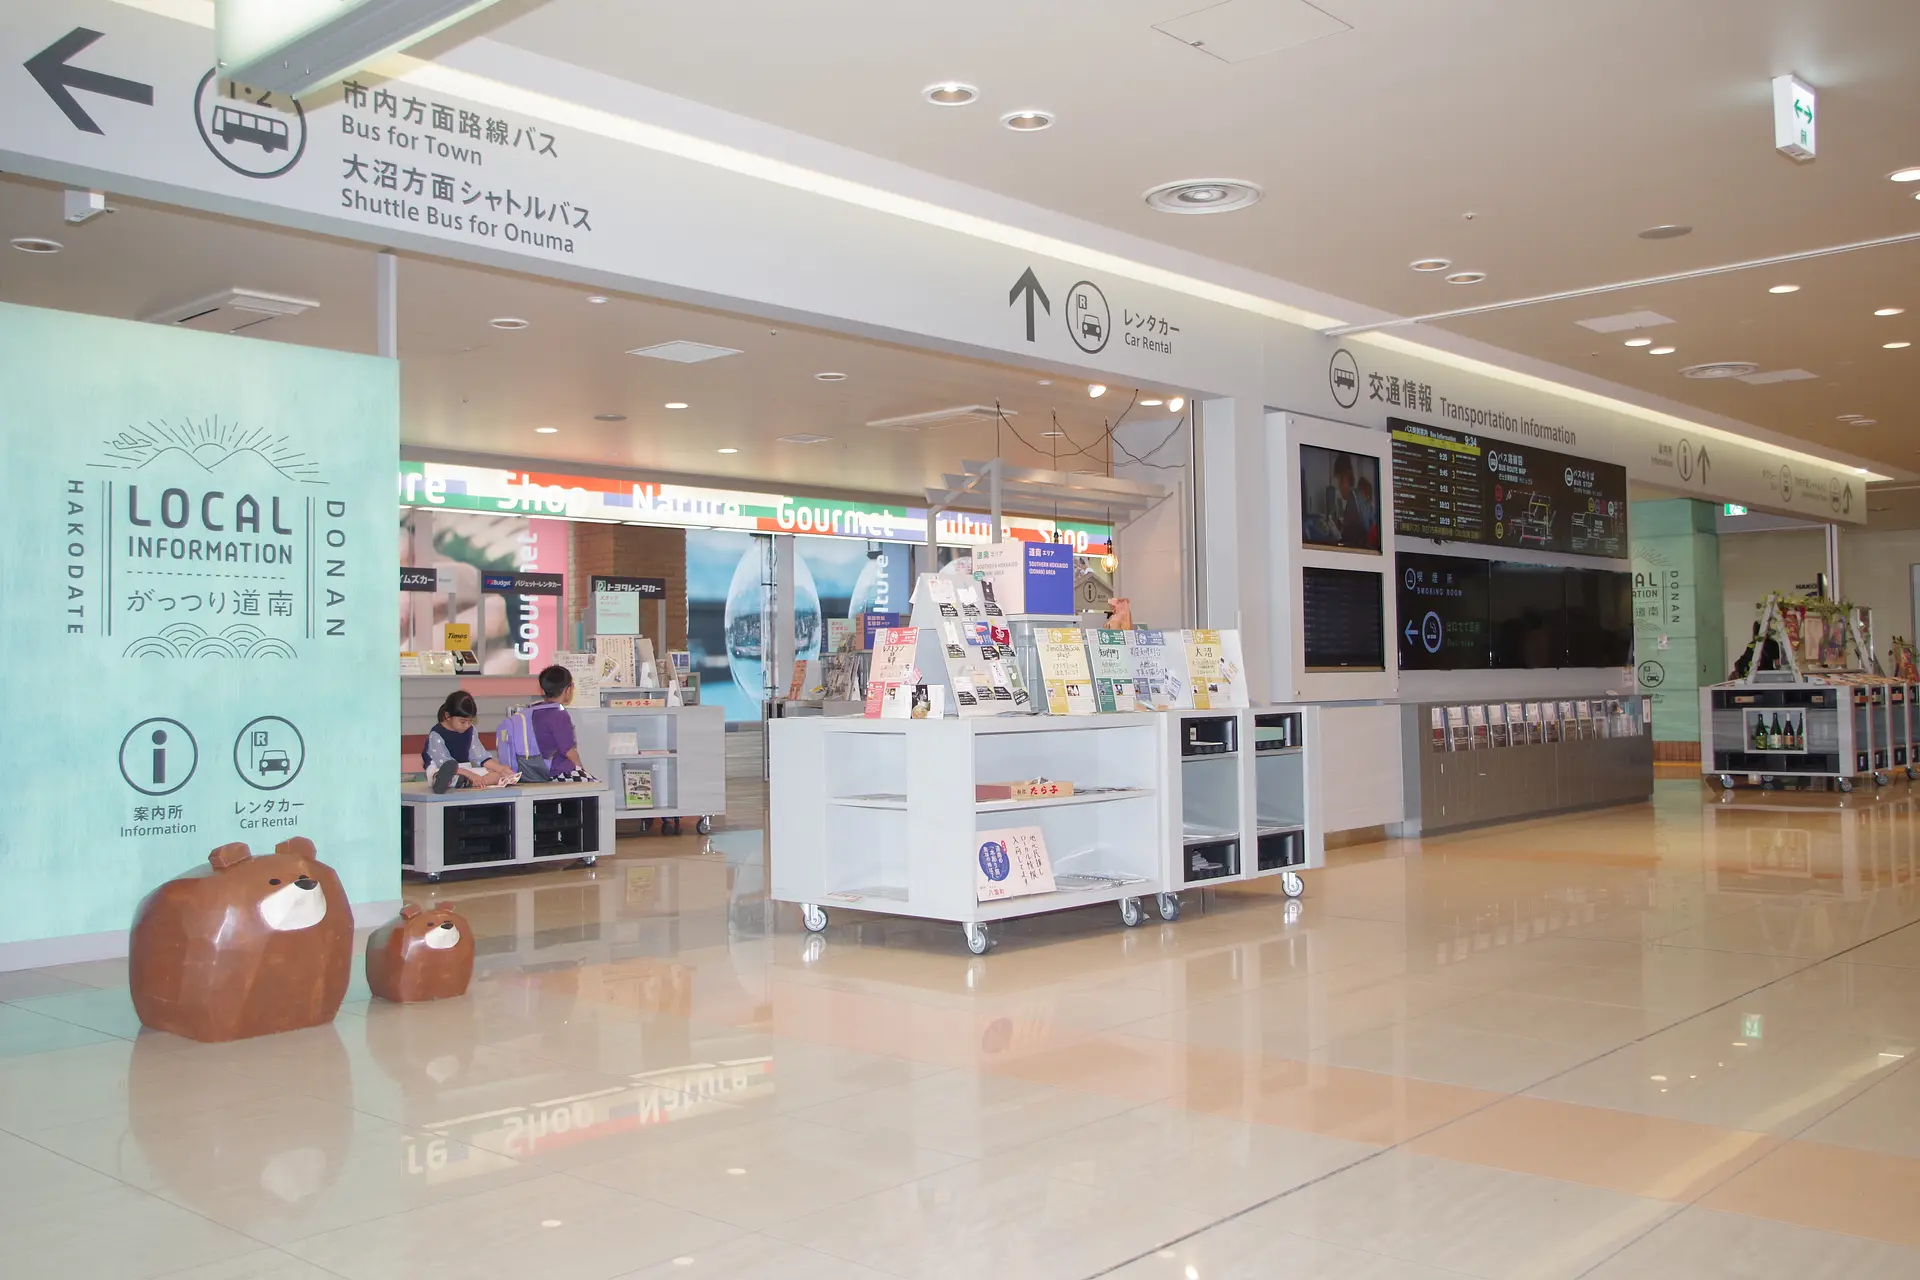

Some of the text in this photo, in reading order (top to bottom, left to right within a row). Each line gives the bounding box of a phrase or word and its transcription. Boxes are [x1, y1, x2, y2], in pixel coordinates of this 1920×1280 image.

[342, 80, 559, 159] 市内方面路線バス
[342, 114, 482, 166] Bus for Town
[342, 154, 592, 232] 大沼方面シャトルバス
[342, 188, 574, 254] Shuttle Bus for Onuma
[1124, 308, 1180, 337] レンタカー
[1124, 332, 1172, 354] Car Rental
[1368, 371, 1433, 413] 交通情報
[1440, 396, 1576, 446] Transportation Information
[1464, 435, 1477, 448] 9:34
[129, 485, 293, 536] LOCAL
[777, 497, 894, 537] Gourmet
[67, 479, 84, 634] HAKODATE
[129, 536, 293, 565] INFORMATION
[326, 500, 346, 636] DONAN
[492, 579, 512, 588] Budget
[607, 583, 662, 593] トヨタレンタカー
[1417, 587, 1463, 597] SMOKING ROOM
[1670, 570, 1680, 623] DONAN
[126, 588, 294, 617] がっつり道南
[448, 632, 468, 640] Times
[1030, 784, 1058, 795] たら子
[133, 804, 183, 821] 案内所
[235, 798, 305, 815] レンタカー
[119, 821, 197, 837] Information
[239, 814, 298, 830] Car Rental
